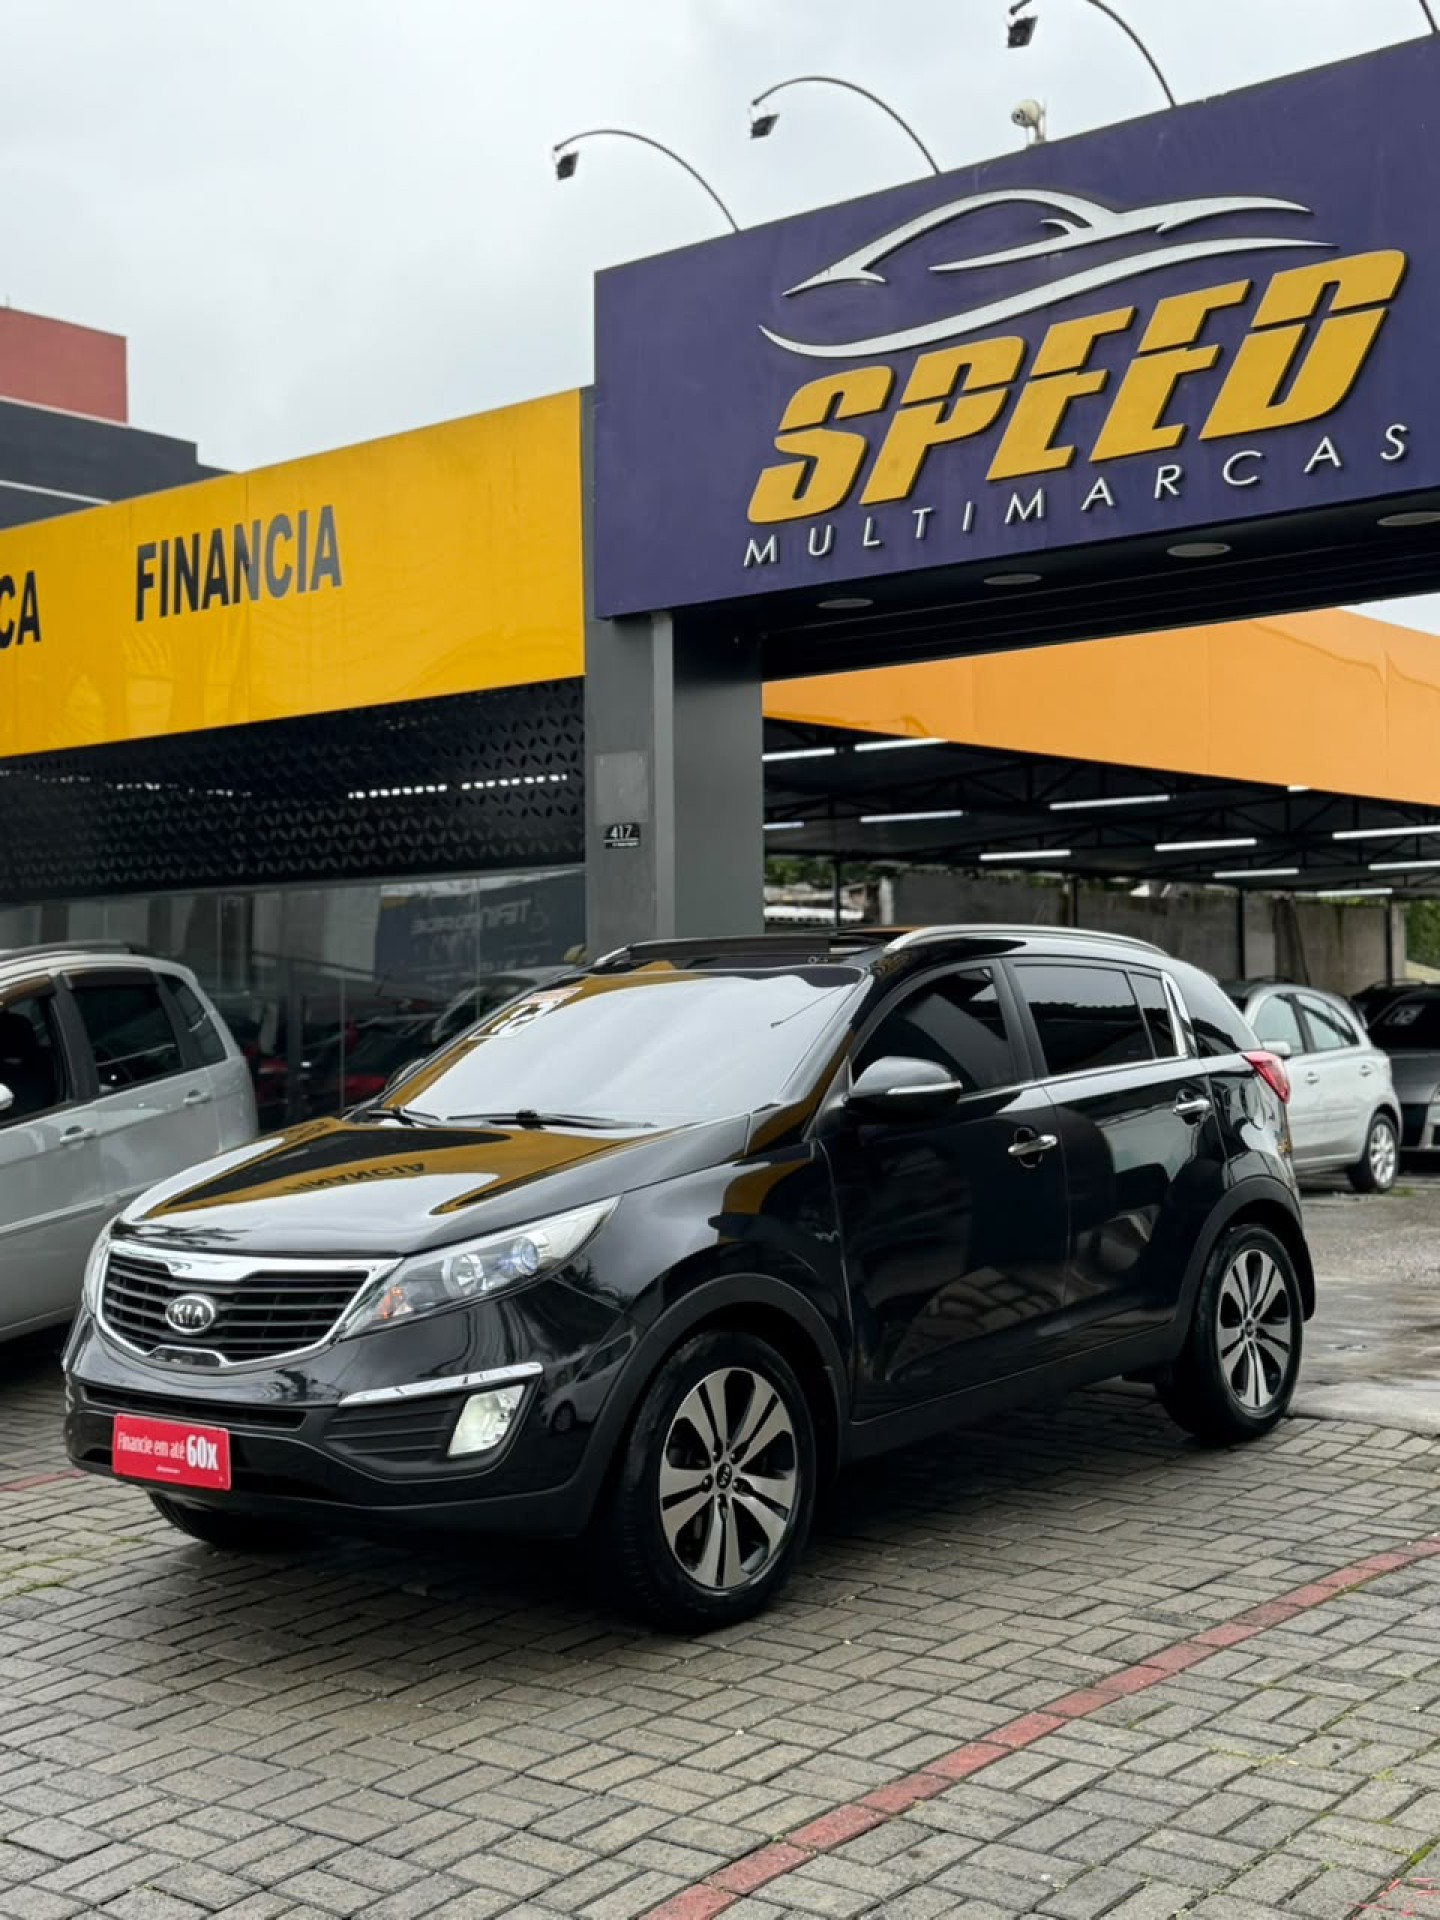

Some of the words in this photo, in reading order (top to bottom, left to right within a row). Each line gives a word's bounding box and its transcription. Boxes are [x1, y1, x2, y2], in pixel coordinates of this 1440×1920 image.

[746, 249, 1406, 524] SPEED
[743, 424, 1409, 568] MULTIMARCAS
[135, 504, 342, 622] FINANCIA
[611, 824, 633, 839] 417
[173, 1304, 205, 1325] KIA
[117, 1431, 153, 1455] Financie
[154, 1440, 168, 1457] em
[170, 1440, 185, 1460] até
[186, 1434, 219, 1470] 60x
